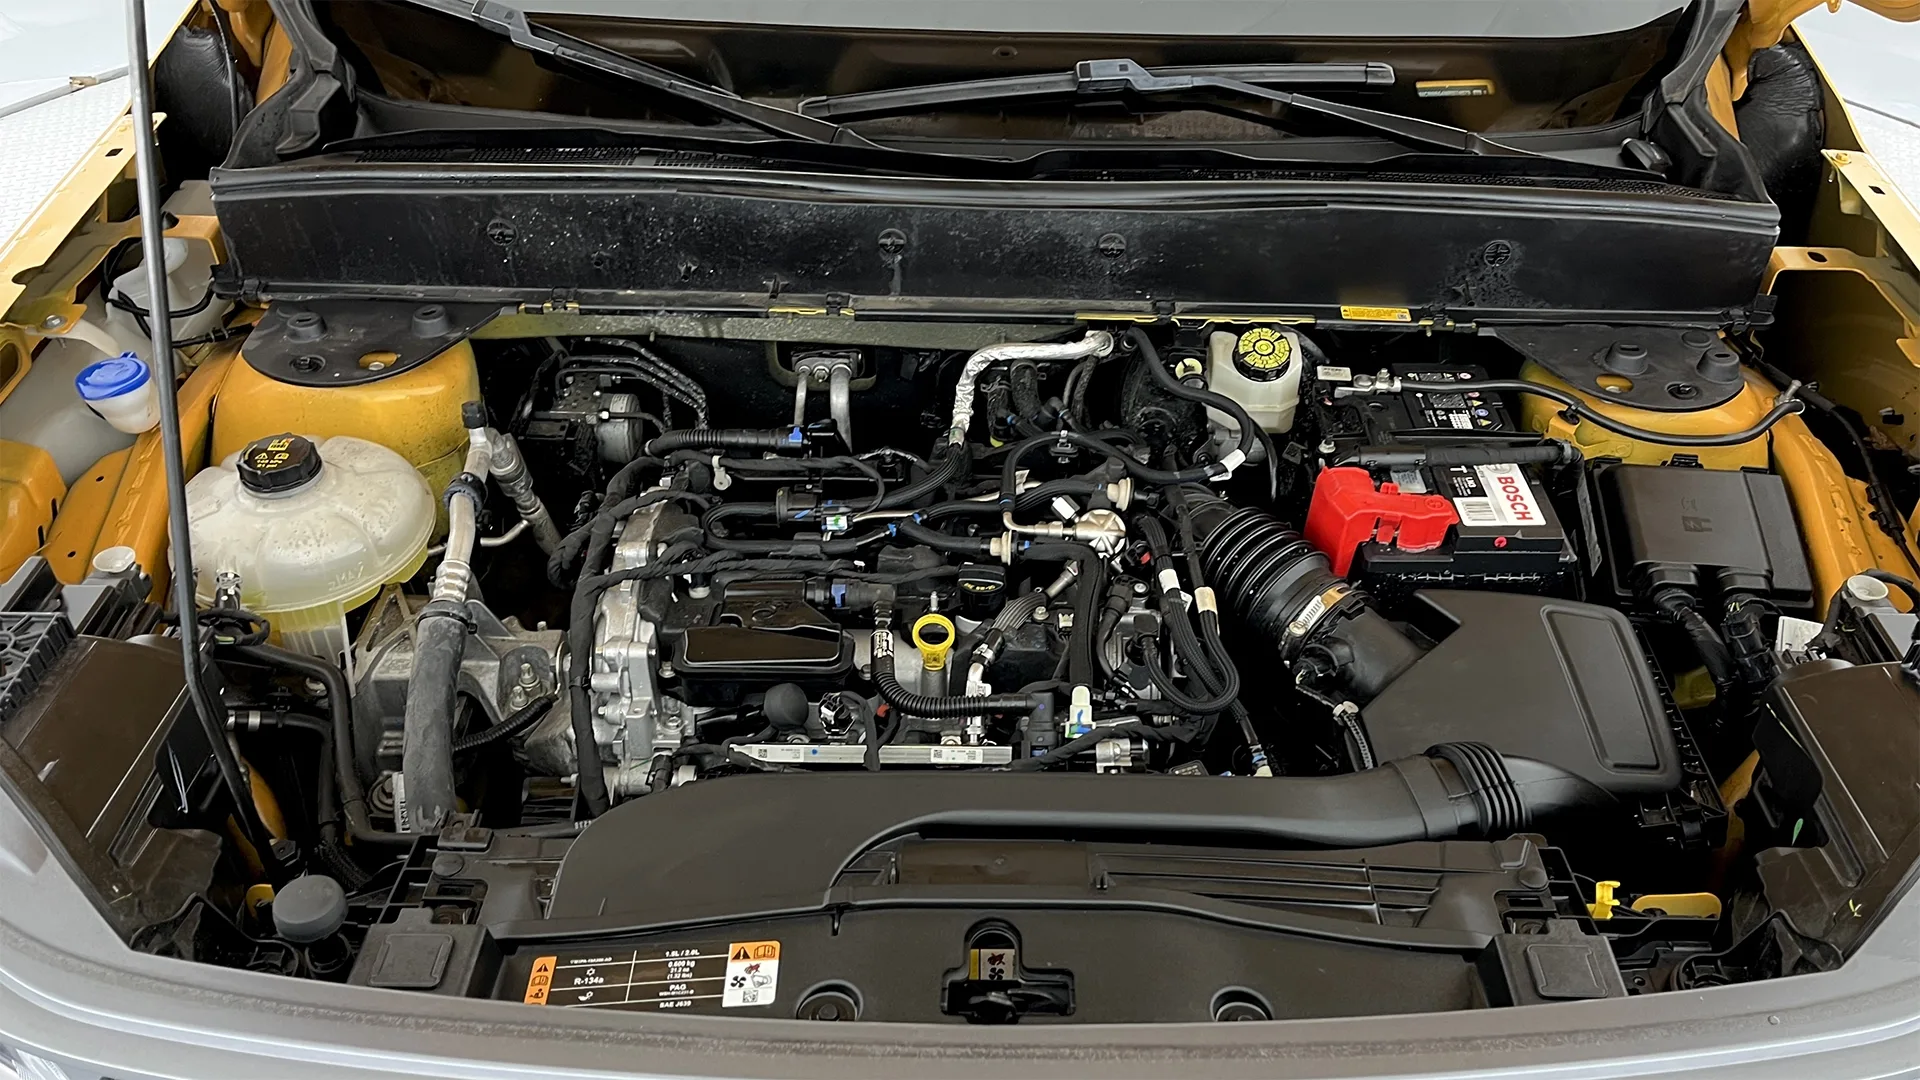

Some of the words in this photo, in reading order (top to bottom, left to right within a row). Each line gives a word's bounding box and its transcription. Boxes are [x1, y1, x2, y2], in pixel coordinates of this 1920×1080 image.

[1496, 476, 1534, 520] BOSCH
[686, 960, 696, 968] kg
[573, 976, 605, 986] R-134a
[669, 983, 688, 991] PAG
[675, 1000, 693, 1008] J639
